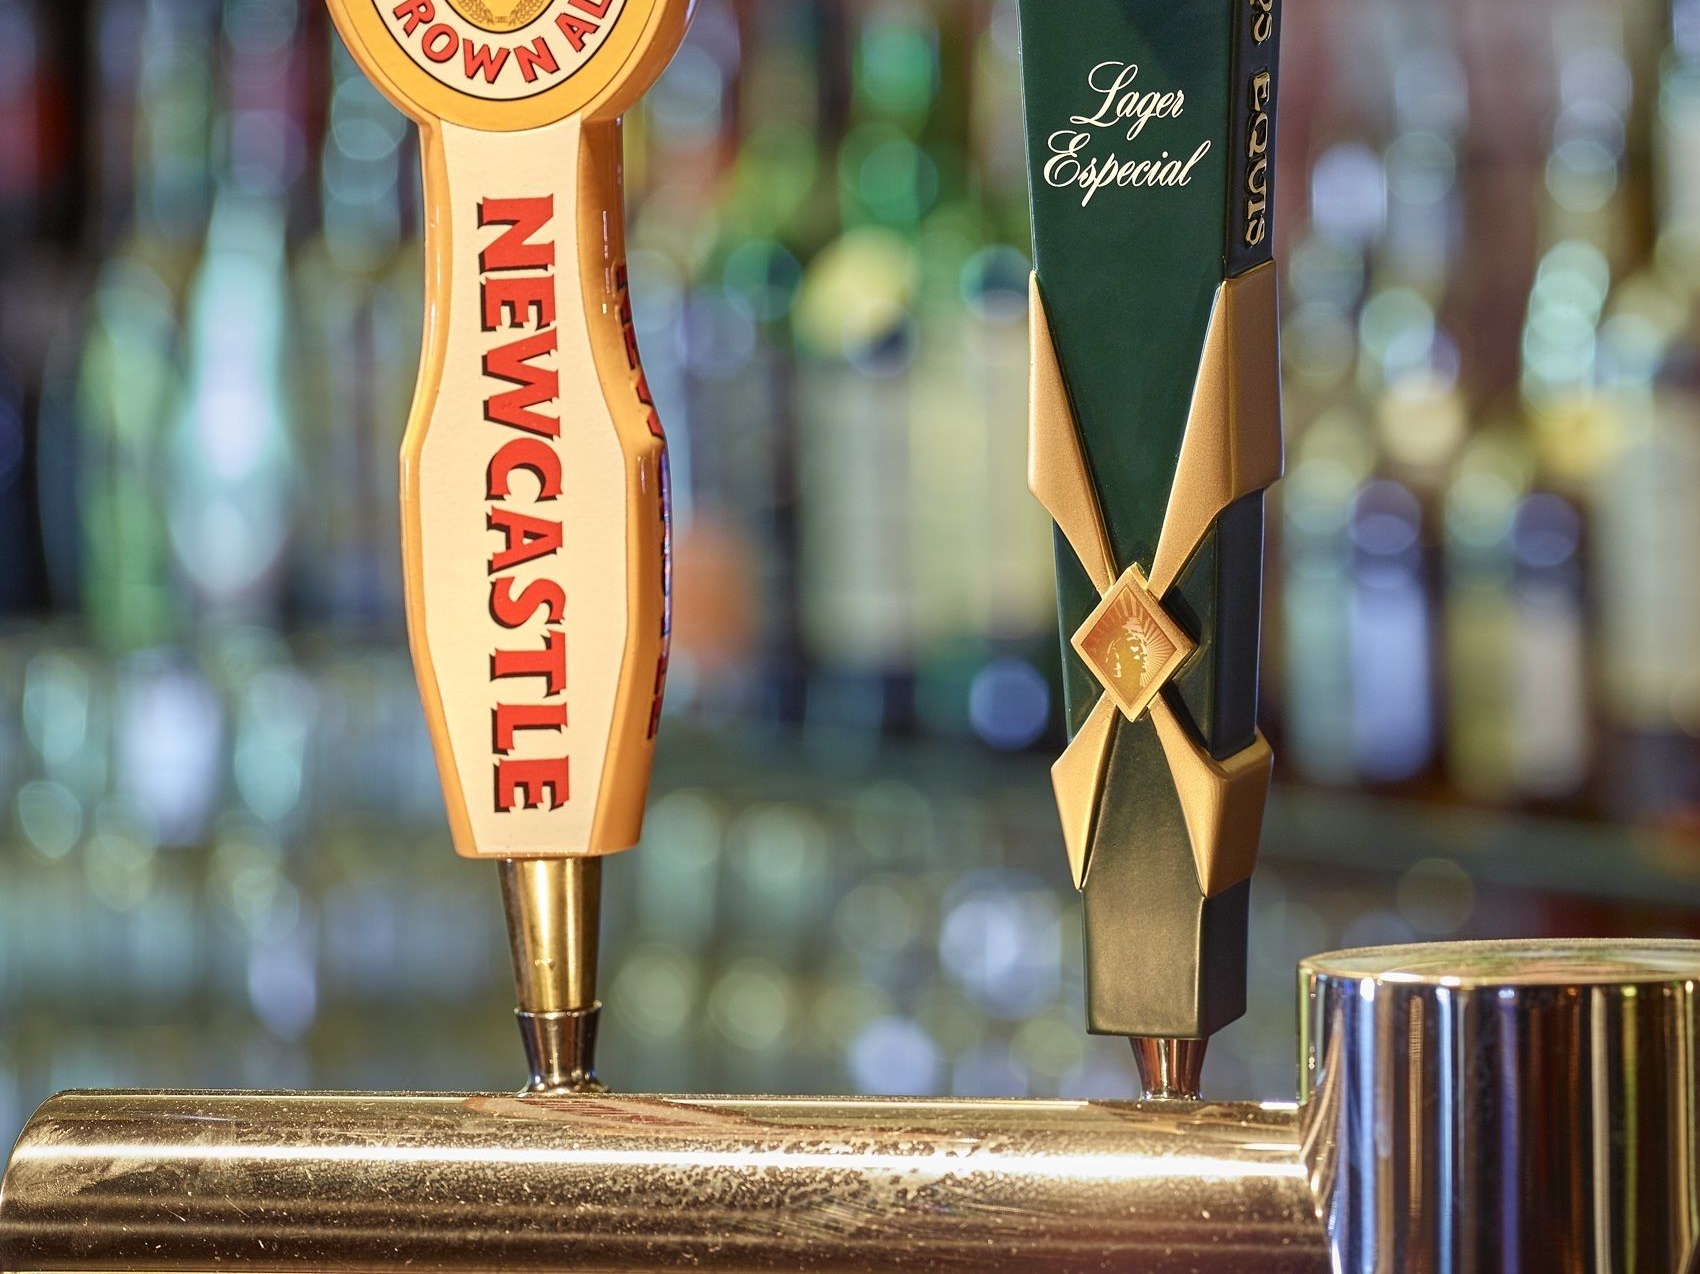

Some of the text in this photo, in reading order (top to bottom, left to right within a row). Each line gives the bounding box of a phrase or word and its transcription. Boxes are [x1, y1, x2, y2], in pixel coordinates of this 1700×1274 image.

[1069, 60, 1185, 141] Lager
[1244, 66, 1271, 247] EQUIS
[1043, 129, 1212, 208] Especial
[476, 192, 571, 813] NEWCASTLE
